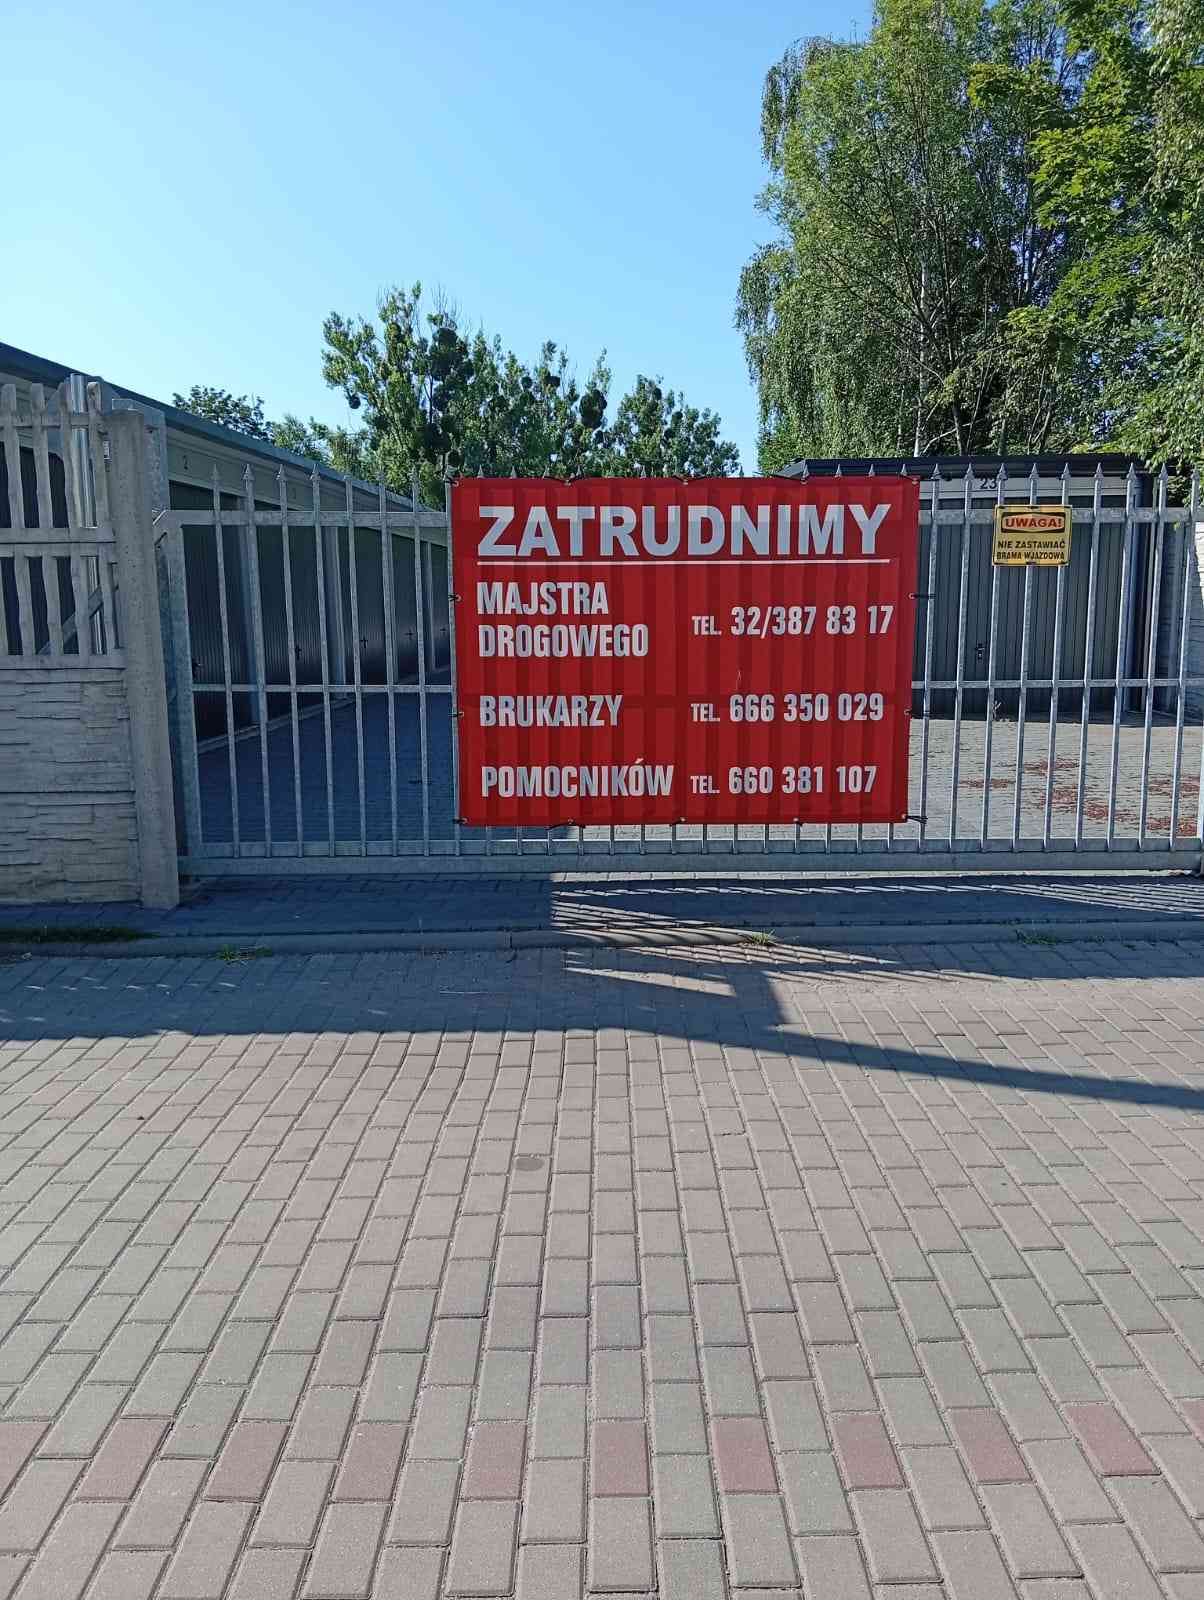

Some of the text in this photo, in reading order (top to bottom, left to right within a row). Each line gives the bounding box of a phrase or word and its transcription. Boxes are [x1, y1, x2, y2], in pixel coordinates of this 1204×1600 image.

[980, 477, 997, 490] 23
[478, 504, 891, 556] ZATRUDNIMY
[1005, 518, 1061, 527] UWAGA!
[997, 551, 1065, 560] BRAMA WJAZDOWA
[998, 539, 1066, 549] NIE ZASTAWIAĆ
[477, 582, 608, 615] MAJSTRA
[692, 606, 893, 638] TEL. 32/387 83 17
[479, 624, 648, 657] DROGOWEGO
[480, 695, 622, 726] BRUKARZY
[691, 693, 883, 721] TEL. 666 350 029
[482, 758, 673, 797] POMOCNIKÓW
[690, 766, 876, 793] TEL. 660 381 107
